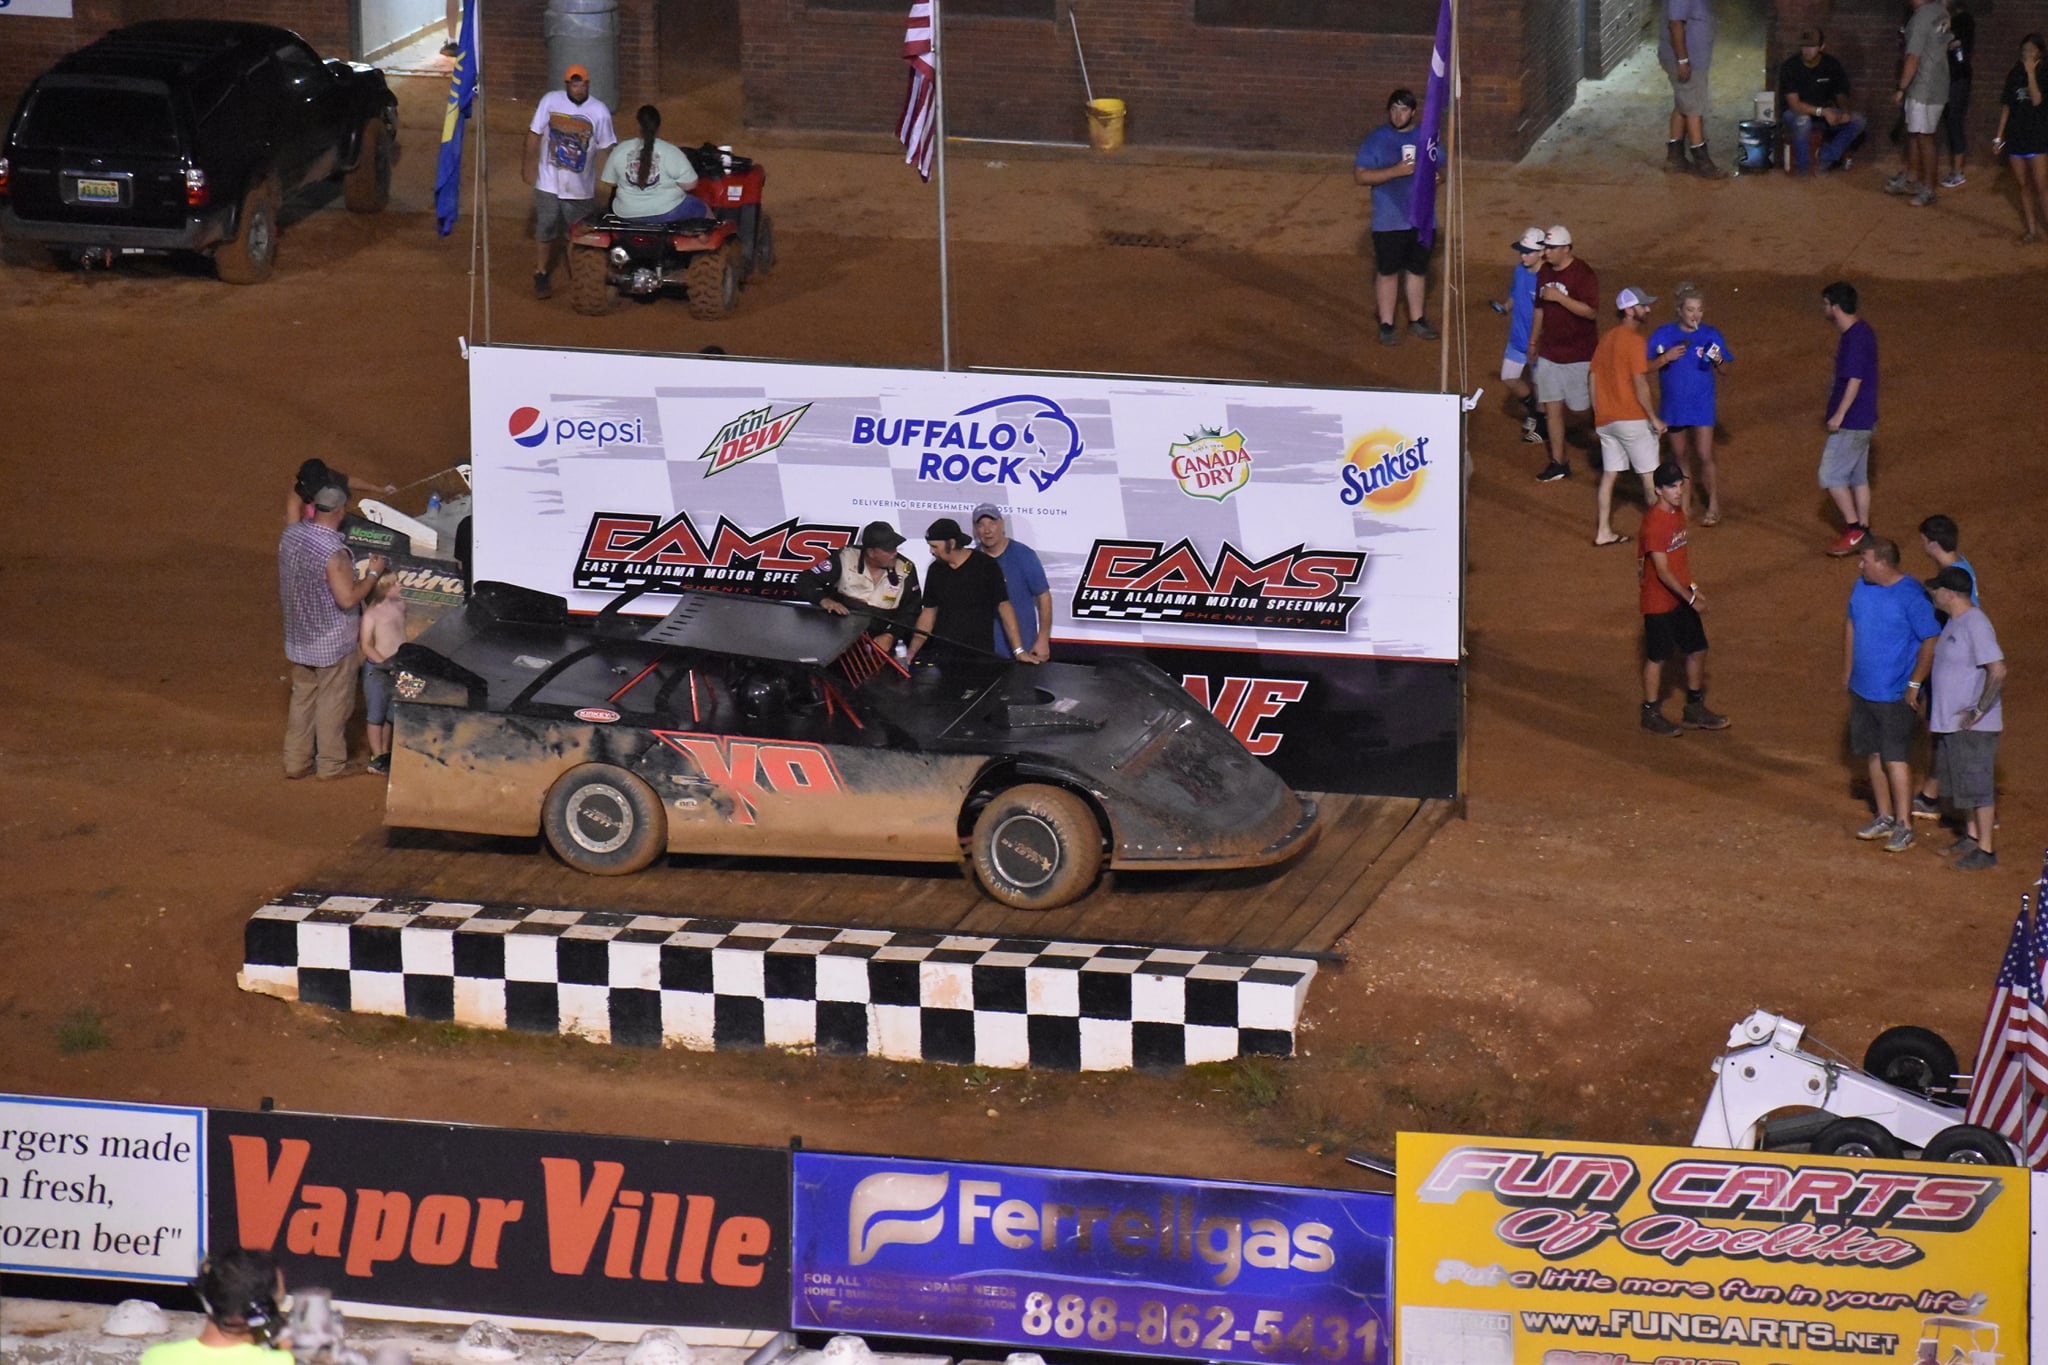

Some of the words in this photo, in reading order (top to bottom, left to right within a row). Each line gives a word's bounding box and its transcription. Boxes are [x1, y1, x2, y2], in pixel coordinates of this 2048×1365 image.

[556, 418, 641, 448] pepsi
[852, 416, 1017, 451] BUFFALO
[918, 452, 1026, 485] ROCK
[1171, 447, 1252, 480] CANADA
[1195, 466, 1234, 489] DRY
[1340, 436, 1429, 506] Sunkist
[852, 498, 907, 509] DELIVERING
[909, 501, 975, 512] REFRESHMENT
[1017, 507, 1034, 515] THE
[1036, 508, 1068, 516] SOUTH
[584, 517, 852, 573] EAMS
[581, 560, 618, 573] EAST
[624, 563, 696, 578] ALABAMA
[703, 567, 755, 581] MOTOR
[762, 571, 800, 585] SPEE
[1085, 545, 1360, 600] EAMS
[1080, 589, 1119, 602] EAST
[1124, 591, 1197, 606] ALABAMA
[1205, 595, 1258, 609] MOTOR
[1266, 598, 1347, 614] SPEEDWAY
[1183, 611, 1255, 622] PHENIX
[1181, 674, 1309, 757] NE
[98, 1131, 192, 1163] made
[22, 1168, 114, 1209] fresh,
[228, 1134, 525, 1278] Vapor
[540, 1156, 772, 1288] Ville
[0, 1225, 80, 1251] ozen
[958, 1179, 1335, 1287] Ferrellgas
[1620, 1212, 1922, 1265] Opelika
[803, 1272, 832, 1285] FOR
[836, 1275, 860, 1287] ALL
[803, 1285, 836, 1297] HOME
[1508, 1270, 1536, 1286] a
[1539, 1268, 1615, 1291] little
[1621, 1279, 1712, 1298] more
[1720, 1279, 1784, 1300] fun
[1787, 1285, 1821, 1304] in
[1824, 1290, 1910, 1311] your
[1021, 1290, 1380, 1364] 888-862-5431
